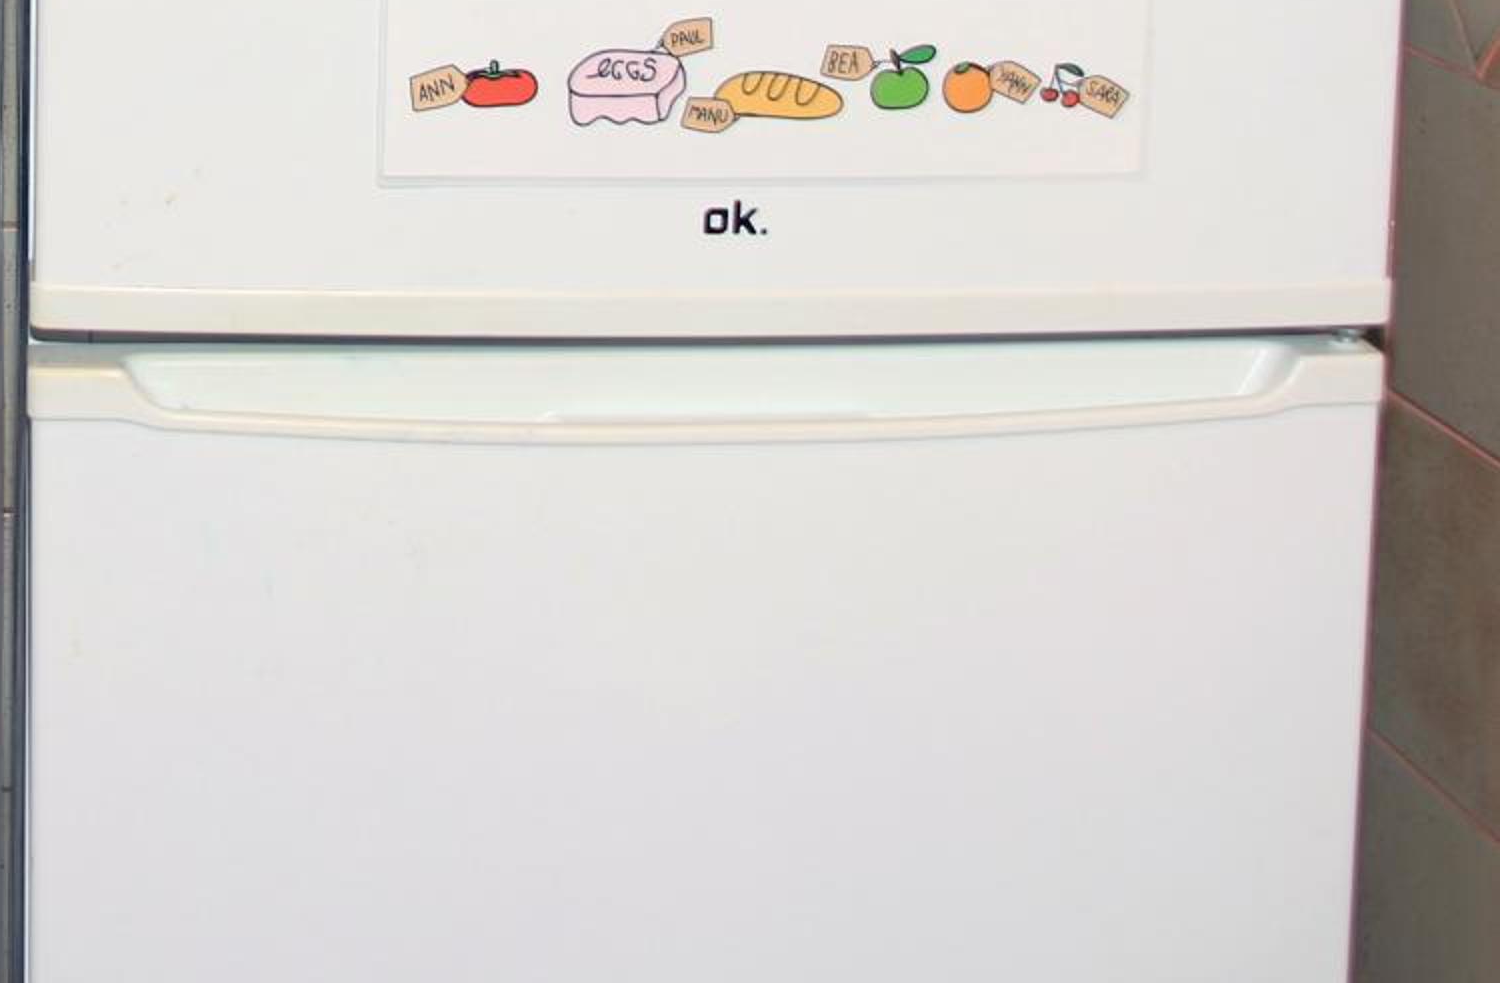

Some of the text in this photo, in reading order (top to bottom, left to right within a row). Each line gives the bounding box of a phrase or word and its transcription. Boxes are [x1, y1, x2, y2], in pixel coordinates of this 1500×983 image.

[670, 29, 705, 47] PAUL
[827, 50, 860, 75] BEA
[419, 73, 455, 102] ANN
[1088, 80, 1121, 105] SARA
[689, 105, 729, 123] MANU
